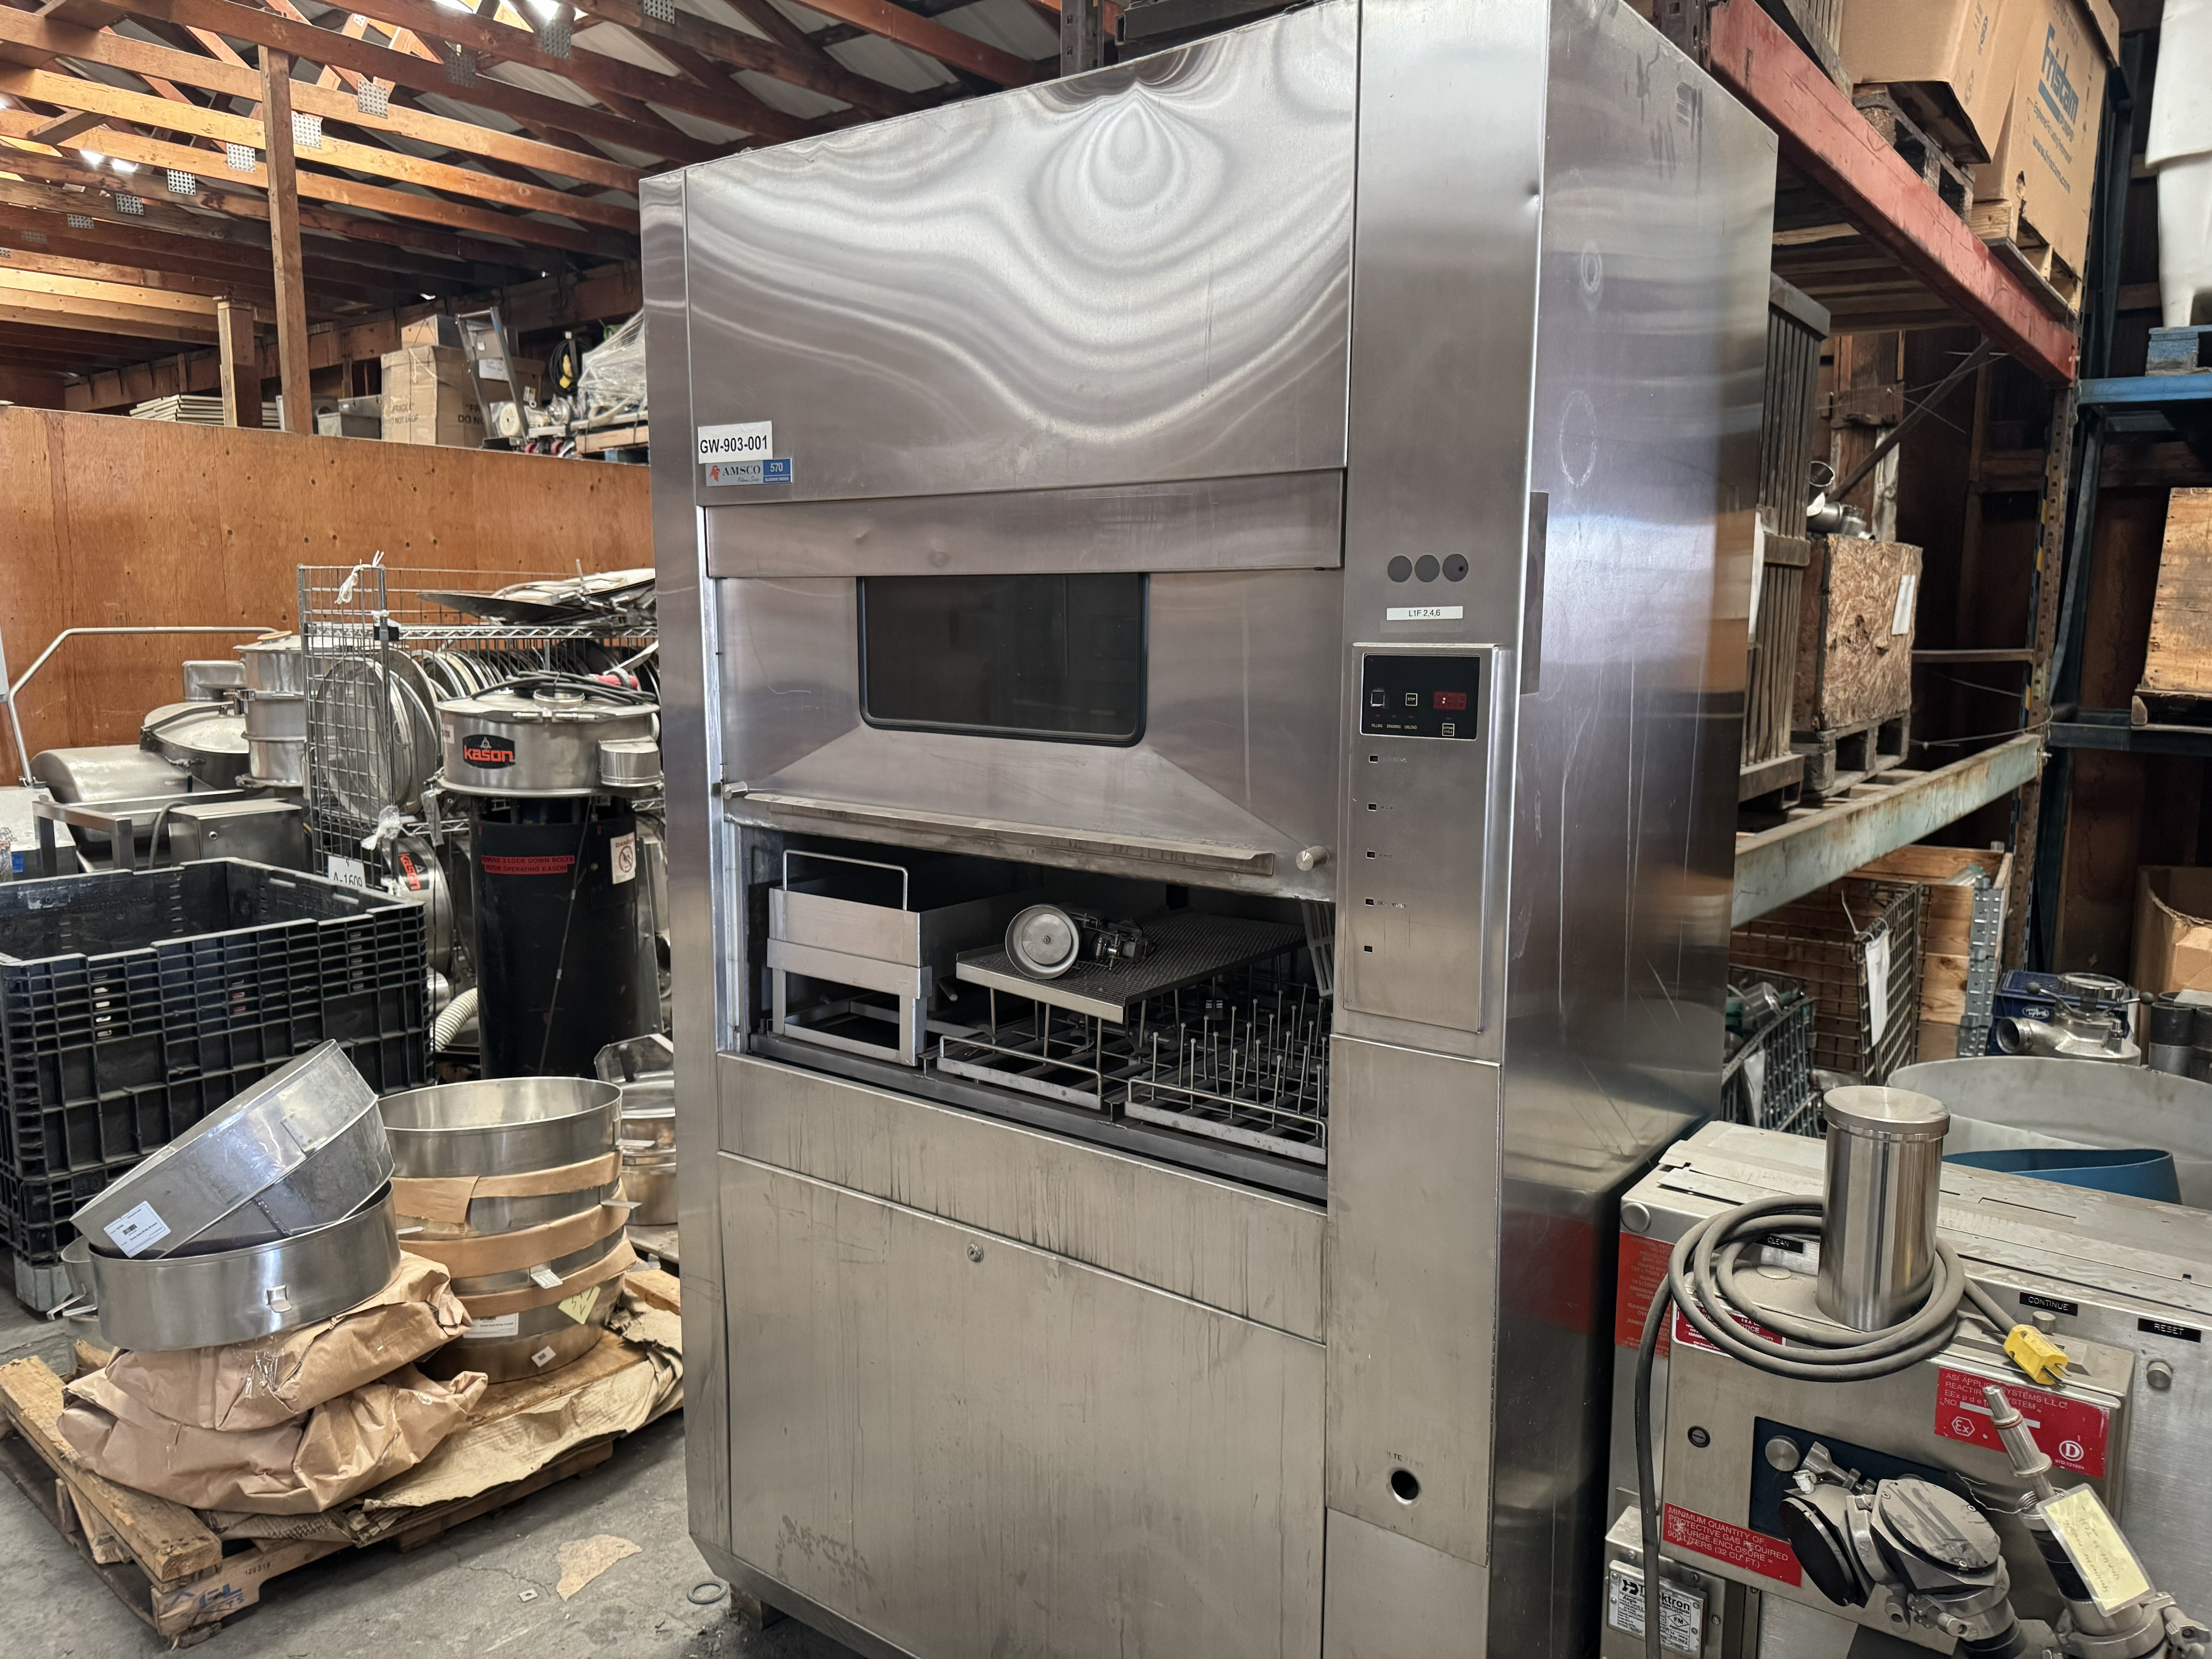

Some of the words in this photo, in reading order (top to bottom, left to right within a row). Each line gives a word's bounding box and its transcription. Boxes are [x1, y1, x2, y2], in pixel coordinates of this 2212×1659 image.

[458, 414, 472, 423] DO
[700, 435, 767, 453] GW-903-001
[723, 465, 761, 476] AMSCO
[770, 462, 783, 472] 570
[1423, 609, 1441, 618] 2,4,6
[464, 745, 514, 763] kason
[398, 853, 421, 890] kason
[1767, 1237, 1789, 1247] CLEAN
[2028, 1296, 2070, 1311] CONTINUE
[2154, 1323, 2184, 1336] RESET
[1945, 1389, 1960, 1398] EEx
[1946, 1373, 1960, 1381] ASI
[1962, 1377, 1992, 1388] APPLIE
[2001, 1387, 2042, 1402] SYSTEMS
[2006, 1397, 2036, 1409] YSTEM
[1669, 1506, 1705, 1524] MINIMUM
[1708, 1521, 1750, 1539] QUANTITY
[1752, 1536, 1765, 1544] OF
[1668, 1515, 1721, 1537] PROTECTIVE
[1723, 1533, 1741, 1544] GAS
[1743, 1540, 1788, 1561] REQUIRED
[1682, 1527, 1711, 1541] PURGE
[1713, 1538, 1765, 1561] ENCLOSURE
[1683, 1535, 1712, 1551] LITERS
[1715, 1546, 1727, 1556] (32
[1674, 1616, 1683, 1625] FM
